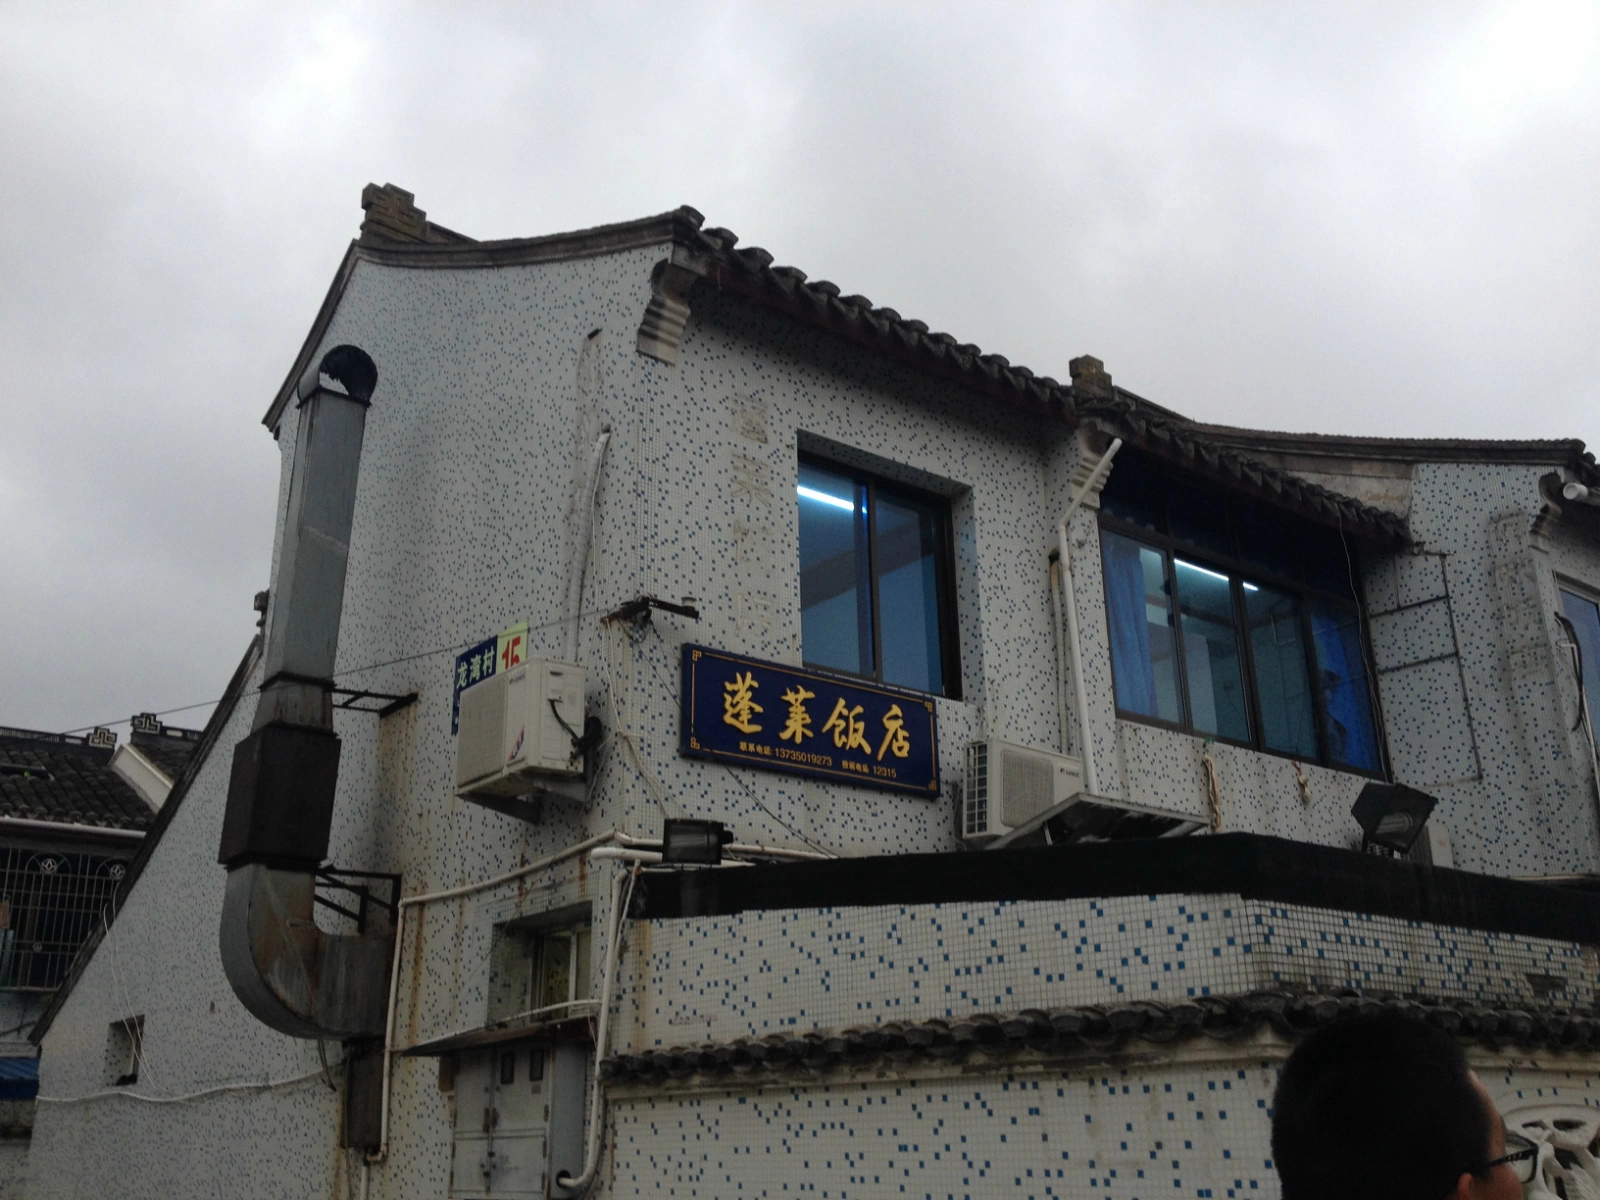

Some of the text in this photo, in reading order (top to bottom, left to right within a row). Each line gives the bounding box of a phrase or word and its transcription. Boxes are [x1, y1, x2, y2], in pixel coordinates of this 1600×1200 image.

[456, 646, 494, 689] 龙湾村
[723, 671, 909, 761] 蓬莱饭店
[775, 748, 832, 767] 13735019273
[873, 765, 897, 779] 12315
